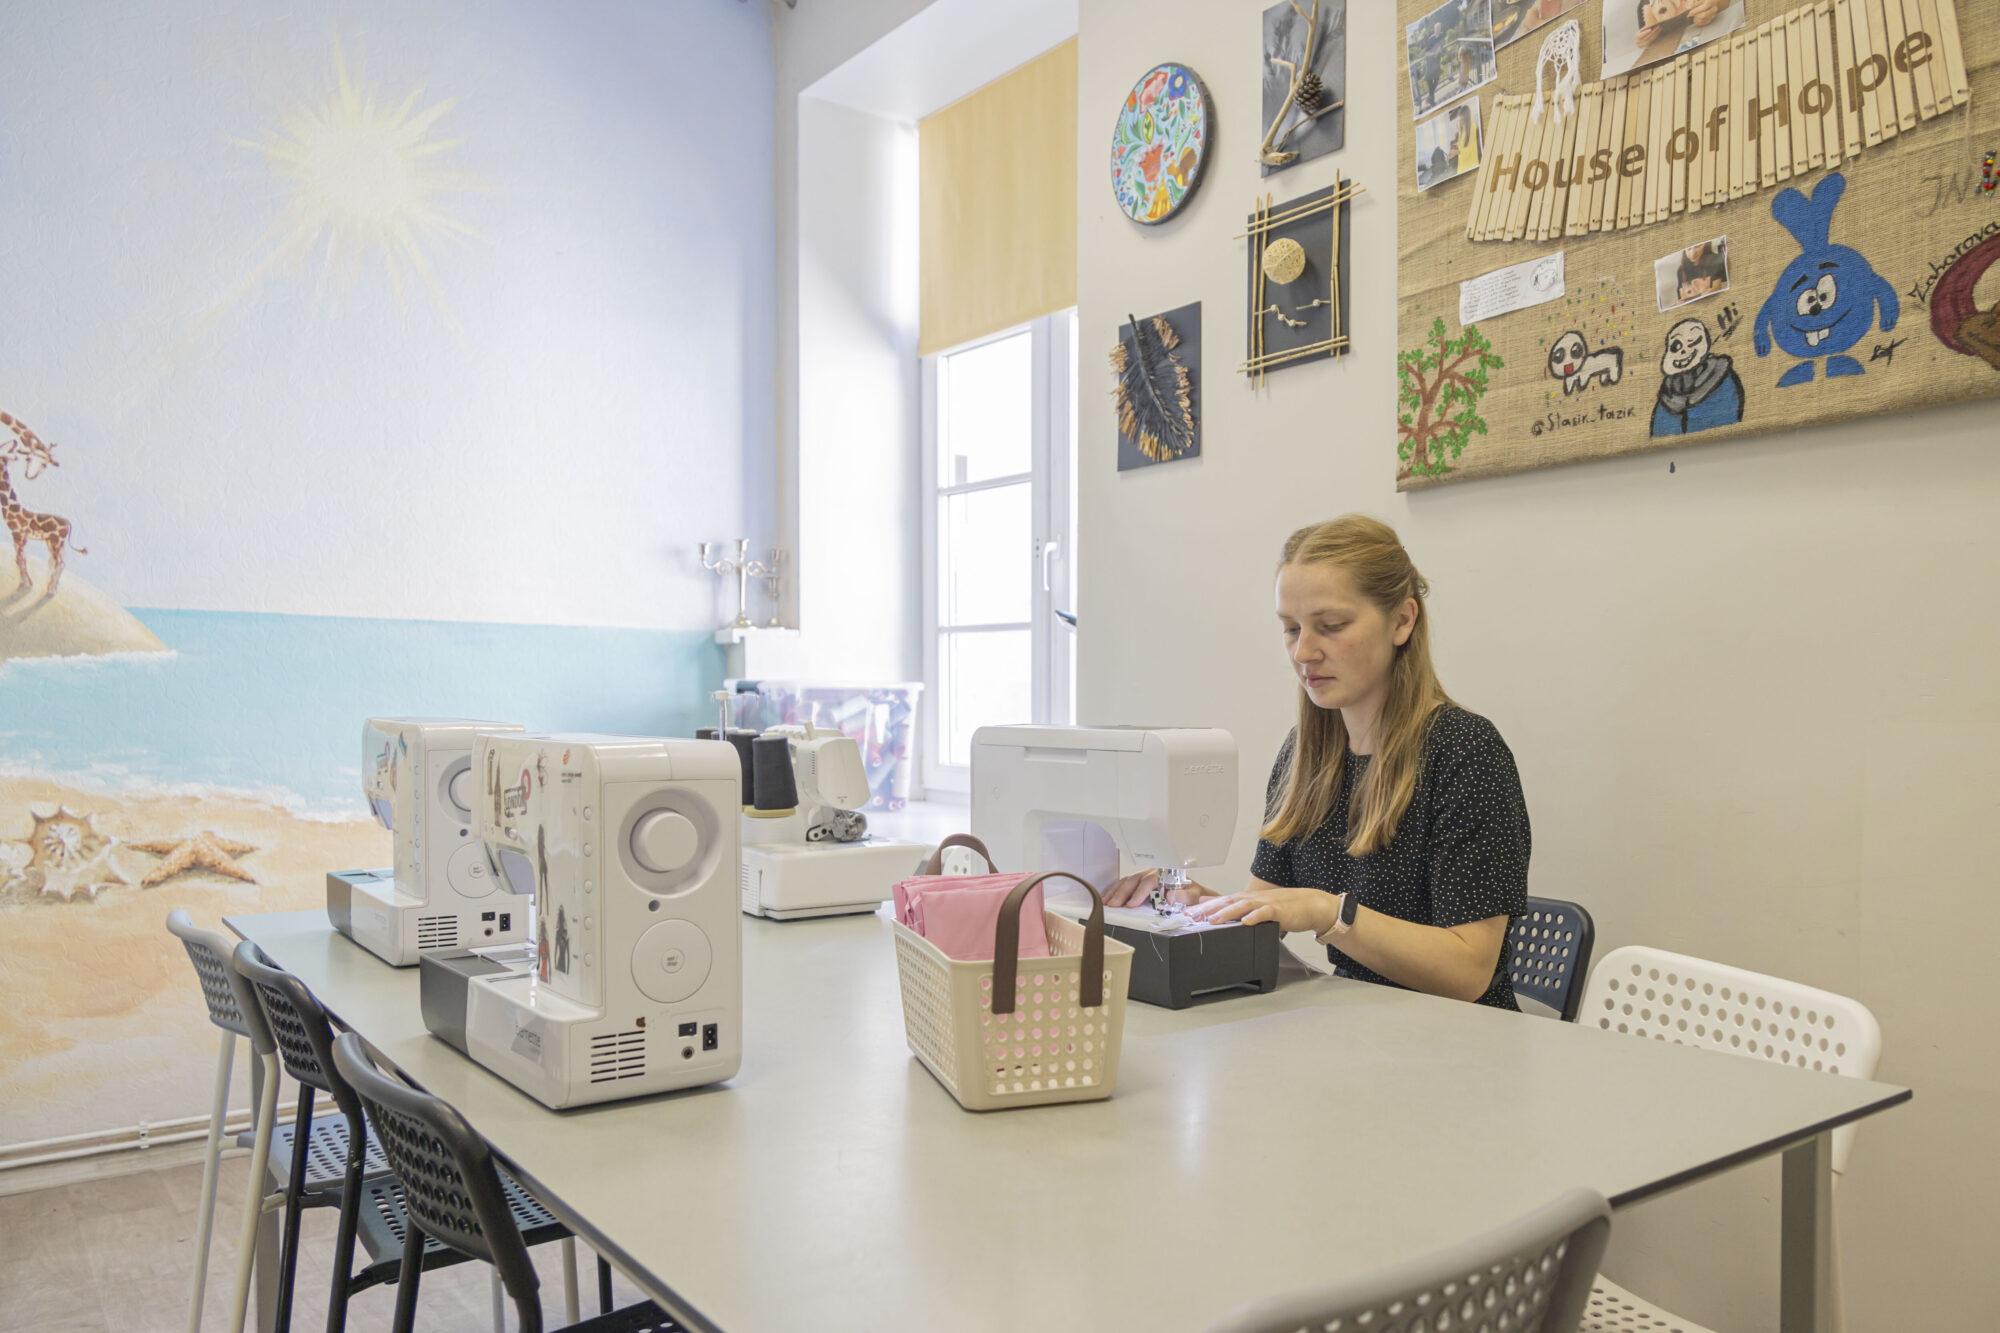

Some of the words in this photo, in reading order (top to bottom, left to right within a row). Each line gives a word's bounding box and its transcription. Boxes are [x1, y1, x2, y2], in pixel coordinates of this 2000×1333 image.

[1489, 142, 1646, 193] House
[1665, 103, 1729, 166] of
[1748, 29, 1933, 142] Hope
[1716, 301, 1739, 330] Hi
